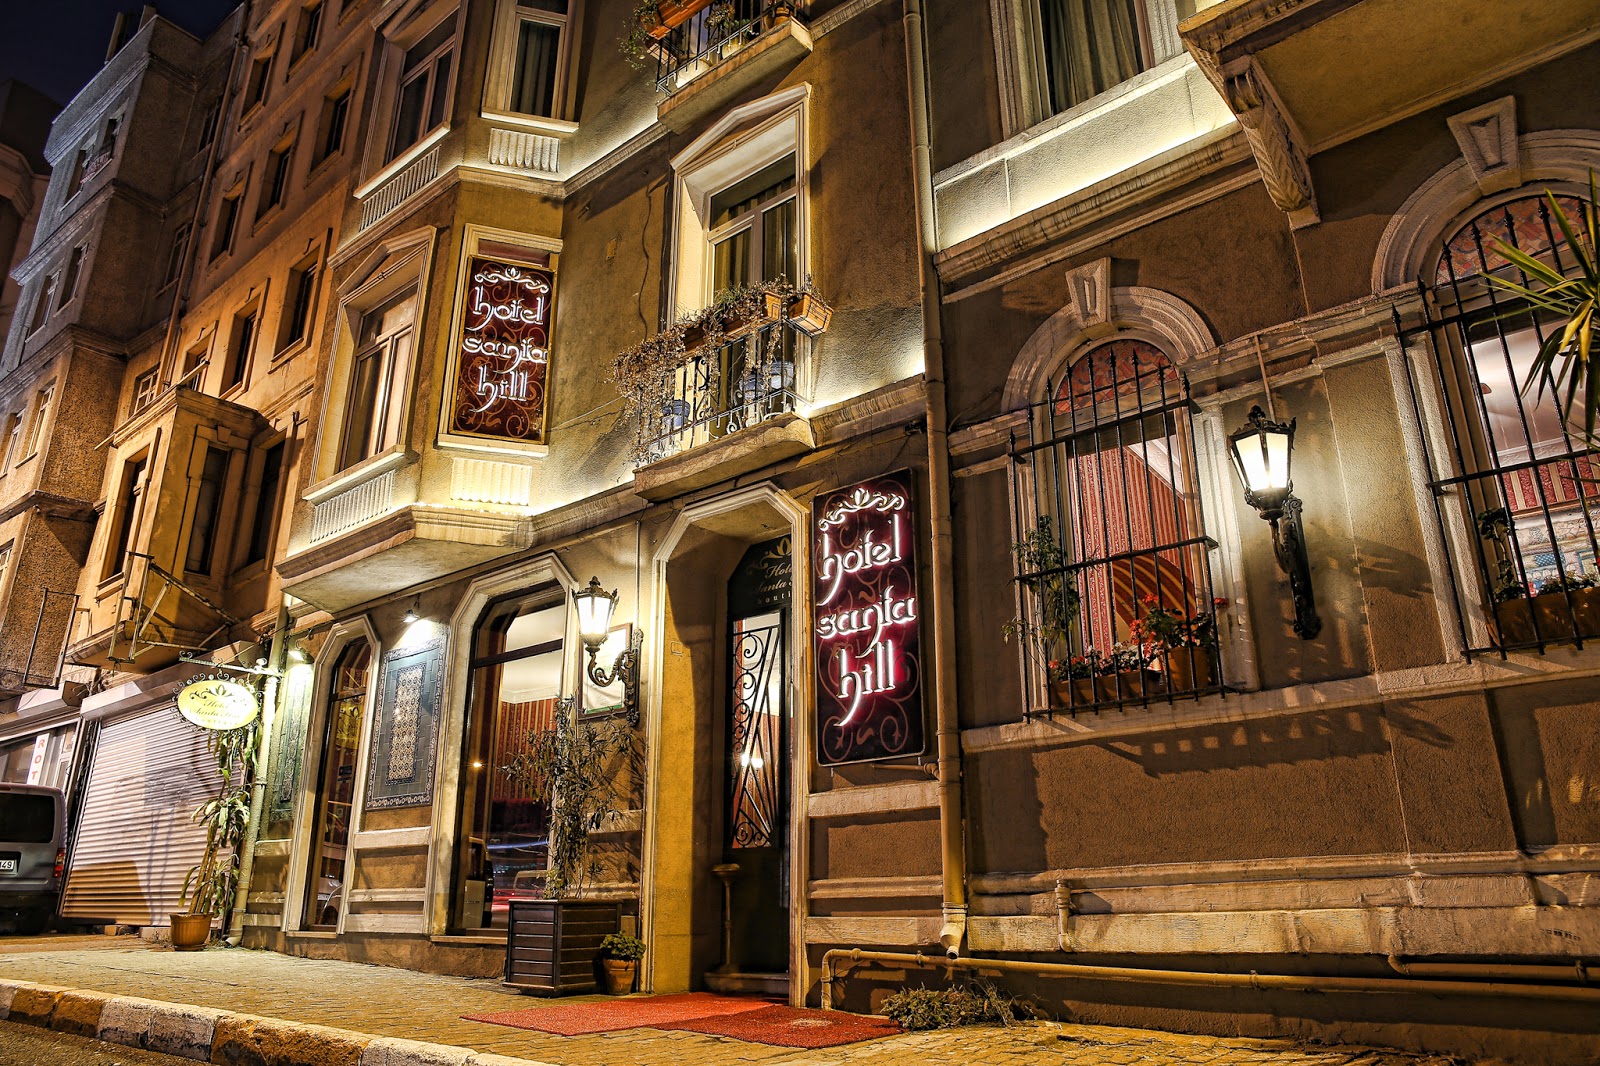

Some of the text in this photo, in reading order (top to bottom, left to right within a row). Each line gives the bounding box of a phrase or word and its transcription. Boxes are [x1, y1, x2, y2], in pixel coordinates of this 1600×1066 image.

[466, 285, 544, 331] hotel
[462, 337, 548, 374] santa
[469, 364, 528, 413] hill
[764, 562, 792, 578] Hote
[816, 514, 901, 606] hotel
[816, 585, 916, 658] santa
[833, 639, 895, 727] hill
